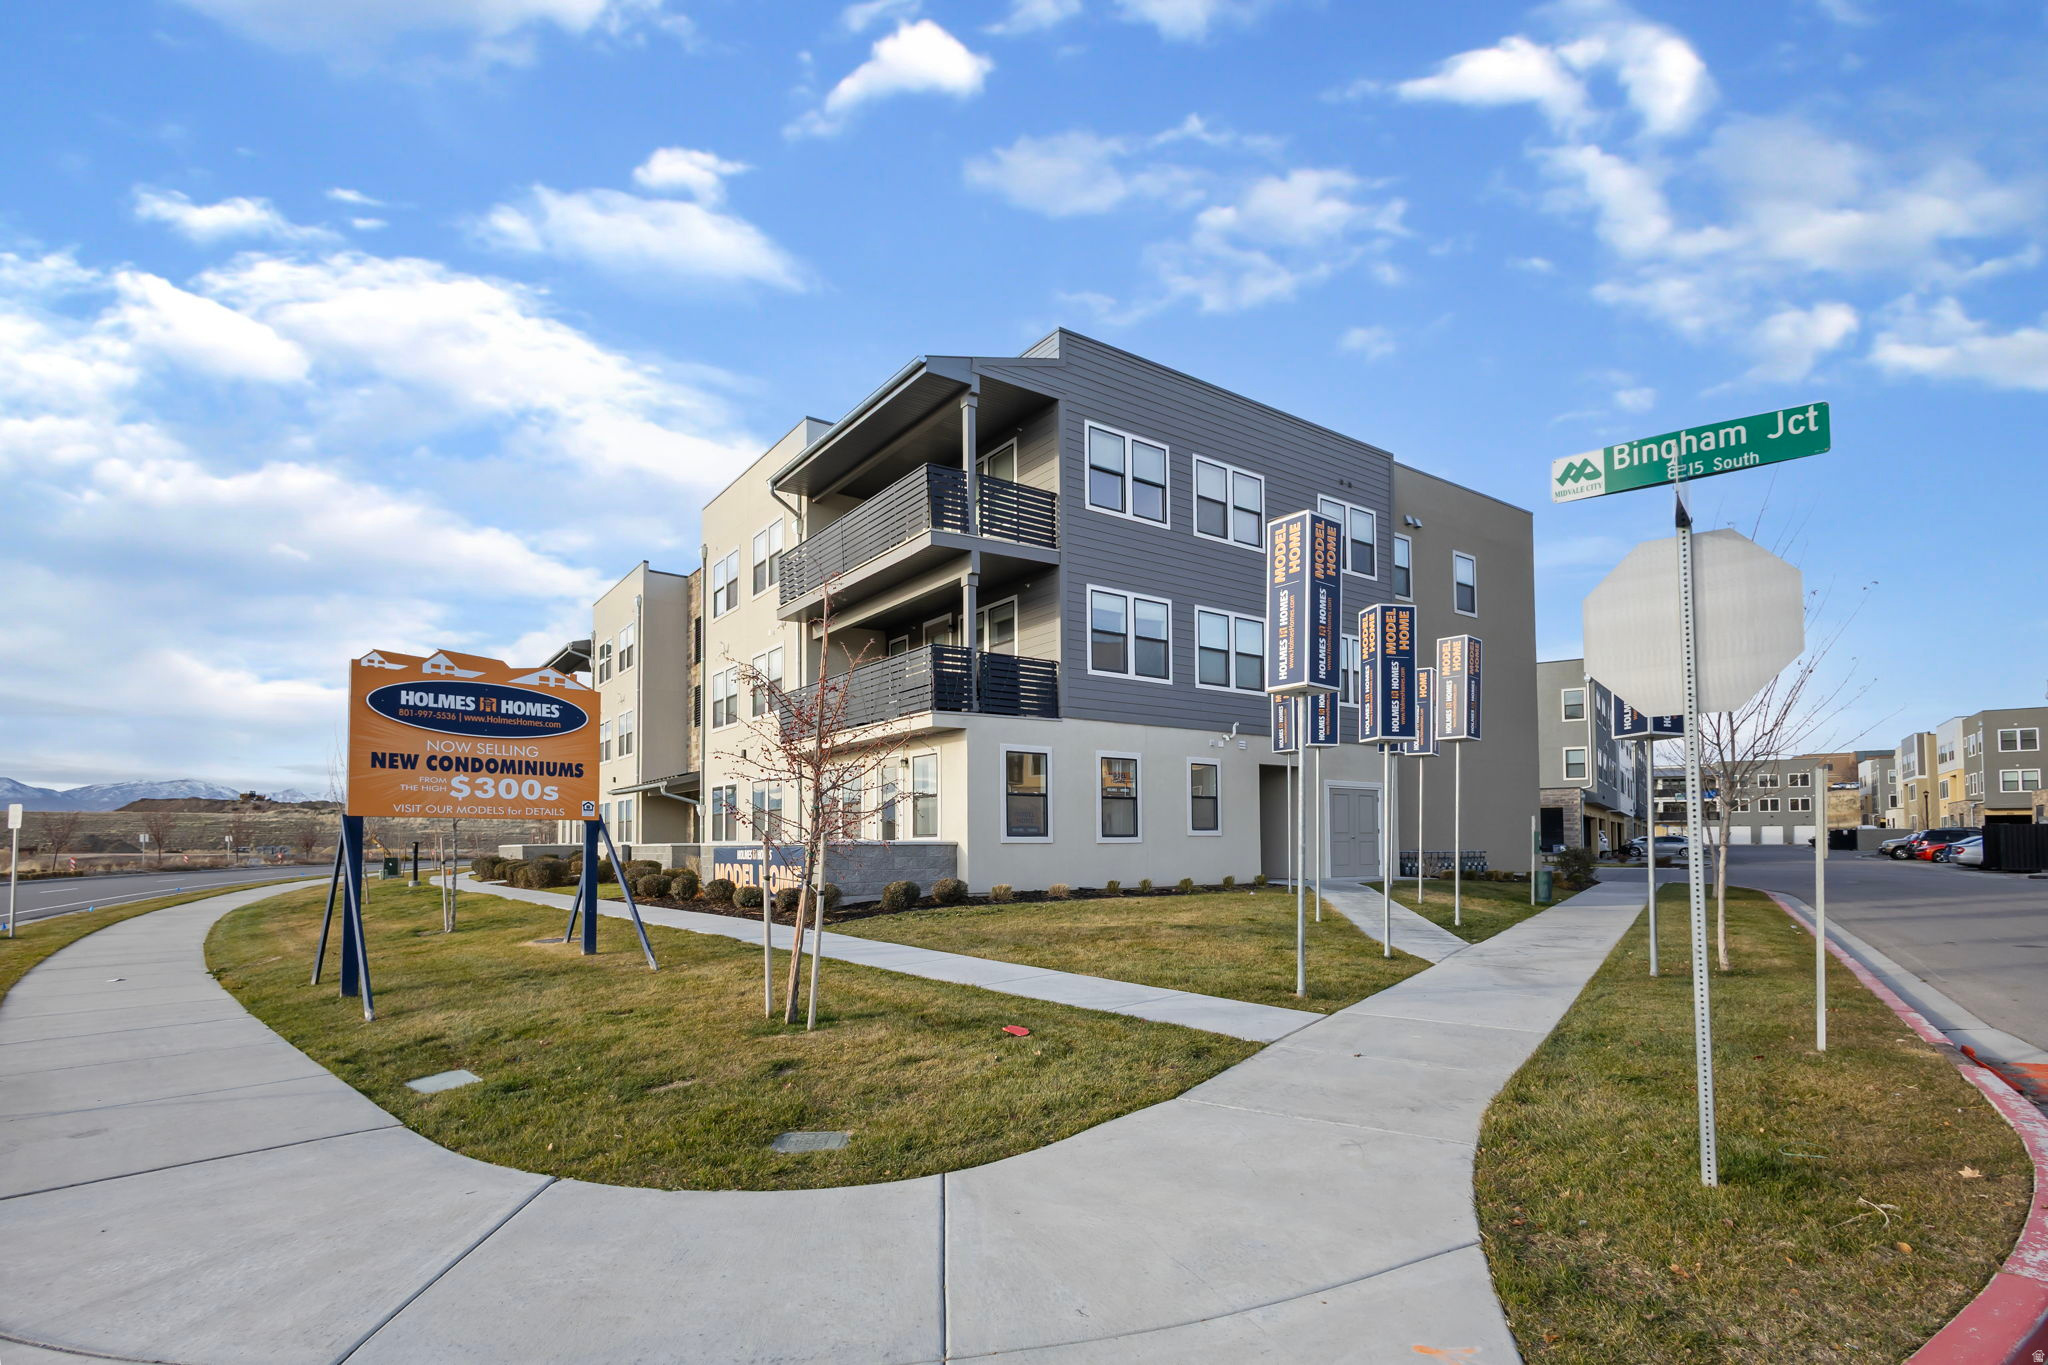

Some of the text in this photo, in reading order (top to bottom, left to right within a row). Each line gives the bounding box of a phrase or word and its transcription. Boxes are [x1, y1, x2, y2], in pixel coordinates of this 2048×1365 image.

[1614, 405, 1819, 470] Bingham Jct
[1713, 452, 1760, 471] South
[1554, 486, 1584, 498] MIDVALE
[1274, 524, 1287, 584] MODEL
[1288, 522, 1300, 574] HOME
[1314, 520, 1325, 579] MODEL
[1327, 526, 1336, 576] HOME
[1279, 589, 1288, 680] HOLMES HOMES
[1386, 608, 1396, 654] MODEL
[1399, 610, 1409, 650] HOME
[1442, 640, 1451, 676] MODEL
[1453, 640, 1461, 672] HOME
[1419, 672, 1427, 698] HOME
[400, 690, 560, 718] HOLMES HOMES
[399, 709, 561, 728] 801-997-5536 www.HolmesHomes.com
[427, 740, 539, 758] NOW SELLING
[371, 752, 584, 777] NEW CONDOMINIUMS
[422, 784, 447, 792] HIGH
[450, 774, 559, 800] $300s
[393, 804, 565, 816] VISIT OUR MODELS for DETAILS
[715, 863, 757, 889] MODEL
